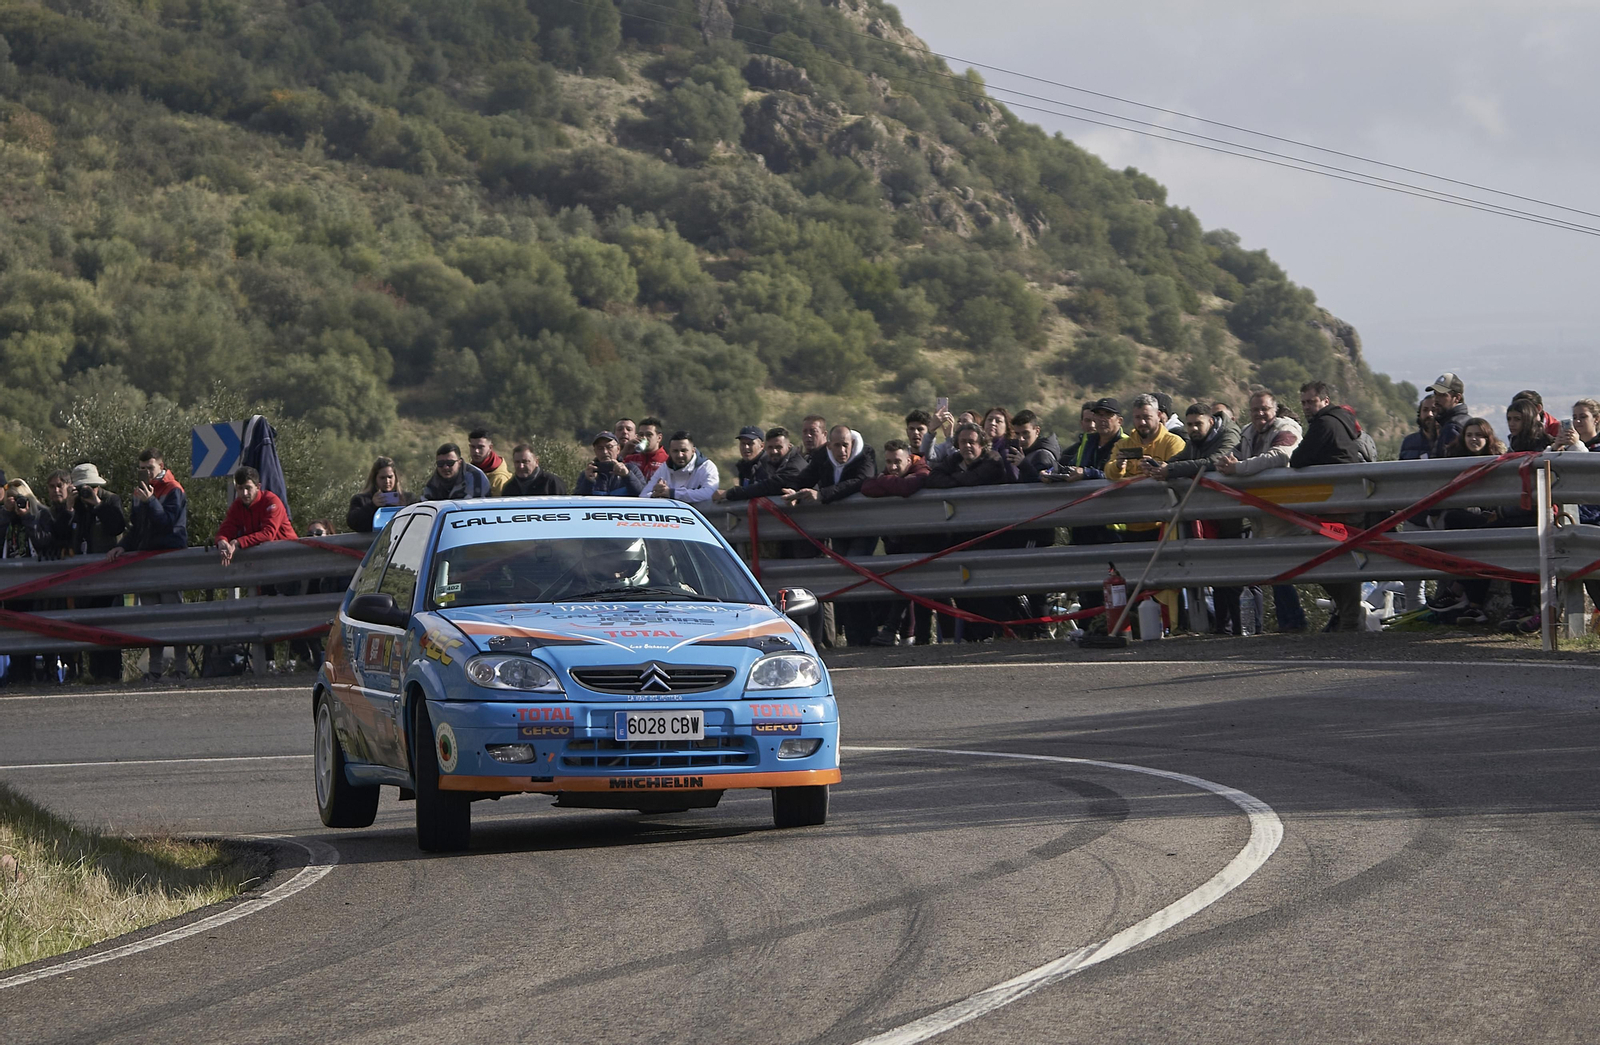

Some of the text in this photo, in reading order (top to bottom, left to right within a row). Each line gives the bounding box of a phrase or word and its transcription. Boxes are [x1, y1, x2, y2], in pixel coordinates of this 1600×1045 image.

[450, 512, 696, 529] TALLERES JEREMIAS
[617, 521, 681, 529] RACING
[603, 630, 683, 638] TOTAL
[517, 707, 574, 721] TOTAL
[751, 704, 802, 716] TOTAL
[522, 725, 569, 736] GEFCO
[627, 716, 700, 735] 6028 CBW
[755, 723, 798, 731] GEFCO
[609, 776, 703, 788] MICHELIN
